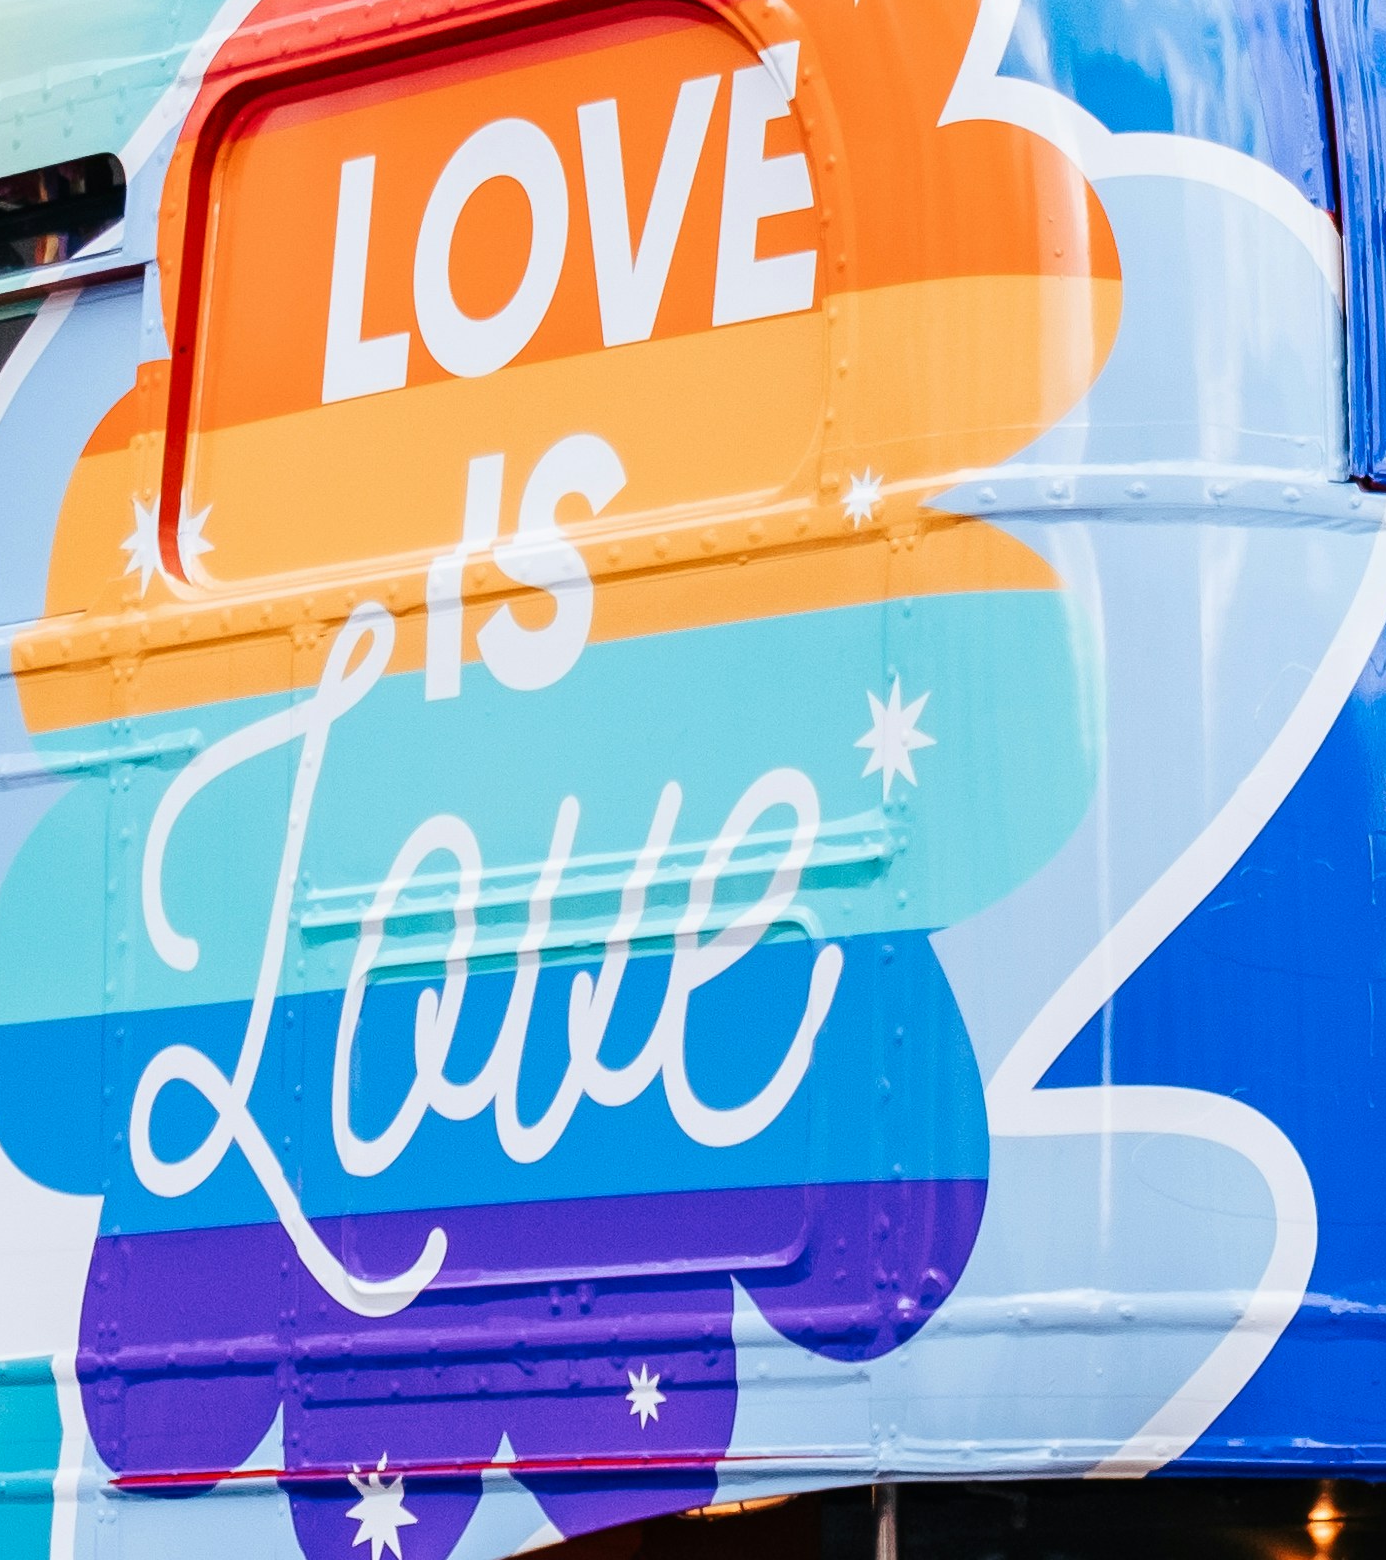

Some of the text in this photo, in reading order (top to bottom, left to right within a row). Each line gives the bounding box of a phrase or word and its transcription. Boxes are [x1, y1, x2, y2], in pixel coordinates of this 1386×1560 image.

[321, 43, 818, 406] LOVE
[424, 432, 626, 701] IS
[128, 600, 842, 1317] Love
